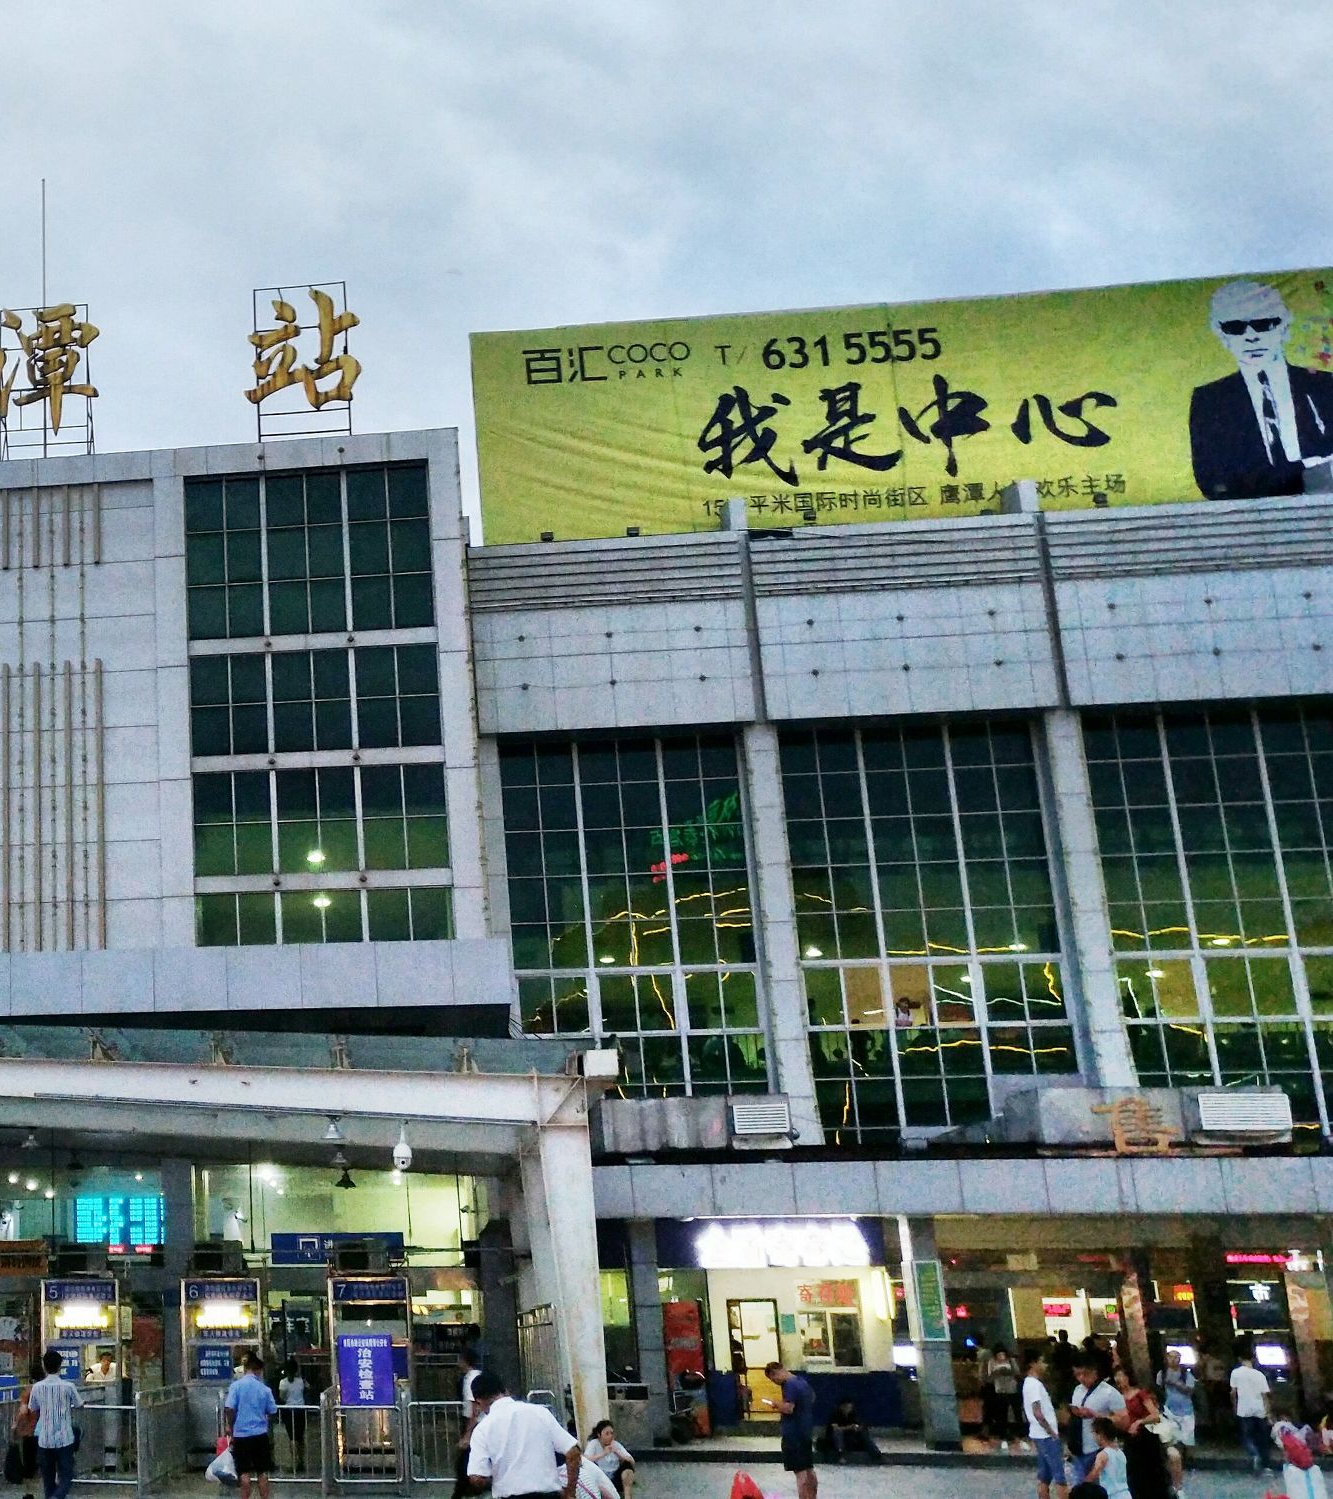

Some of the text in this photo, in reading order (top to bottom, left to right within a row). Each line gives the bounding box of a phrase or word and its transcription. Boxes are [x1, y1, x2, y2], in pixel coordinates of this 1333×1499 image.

[522, 346, 607, 385] 百汇
[607, 341, 691, 365] COCO
[618, 367, 683, 379] PARK
[698, 373, 1118, 487] 我是中心
[703, 474, 1127, 516] 15平米国际时尚街区 鹰潭人欢乐主场
[49, 1286, 58, 1299] 5
[189, 1284, 199, 1298] 6
[336, 1283, 347, 1298] 7
[357, 1347, 374, 1401] 治安检查站
